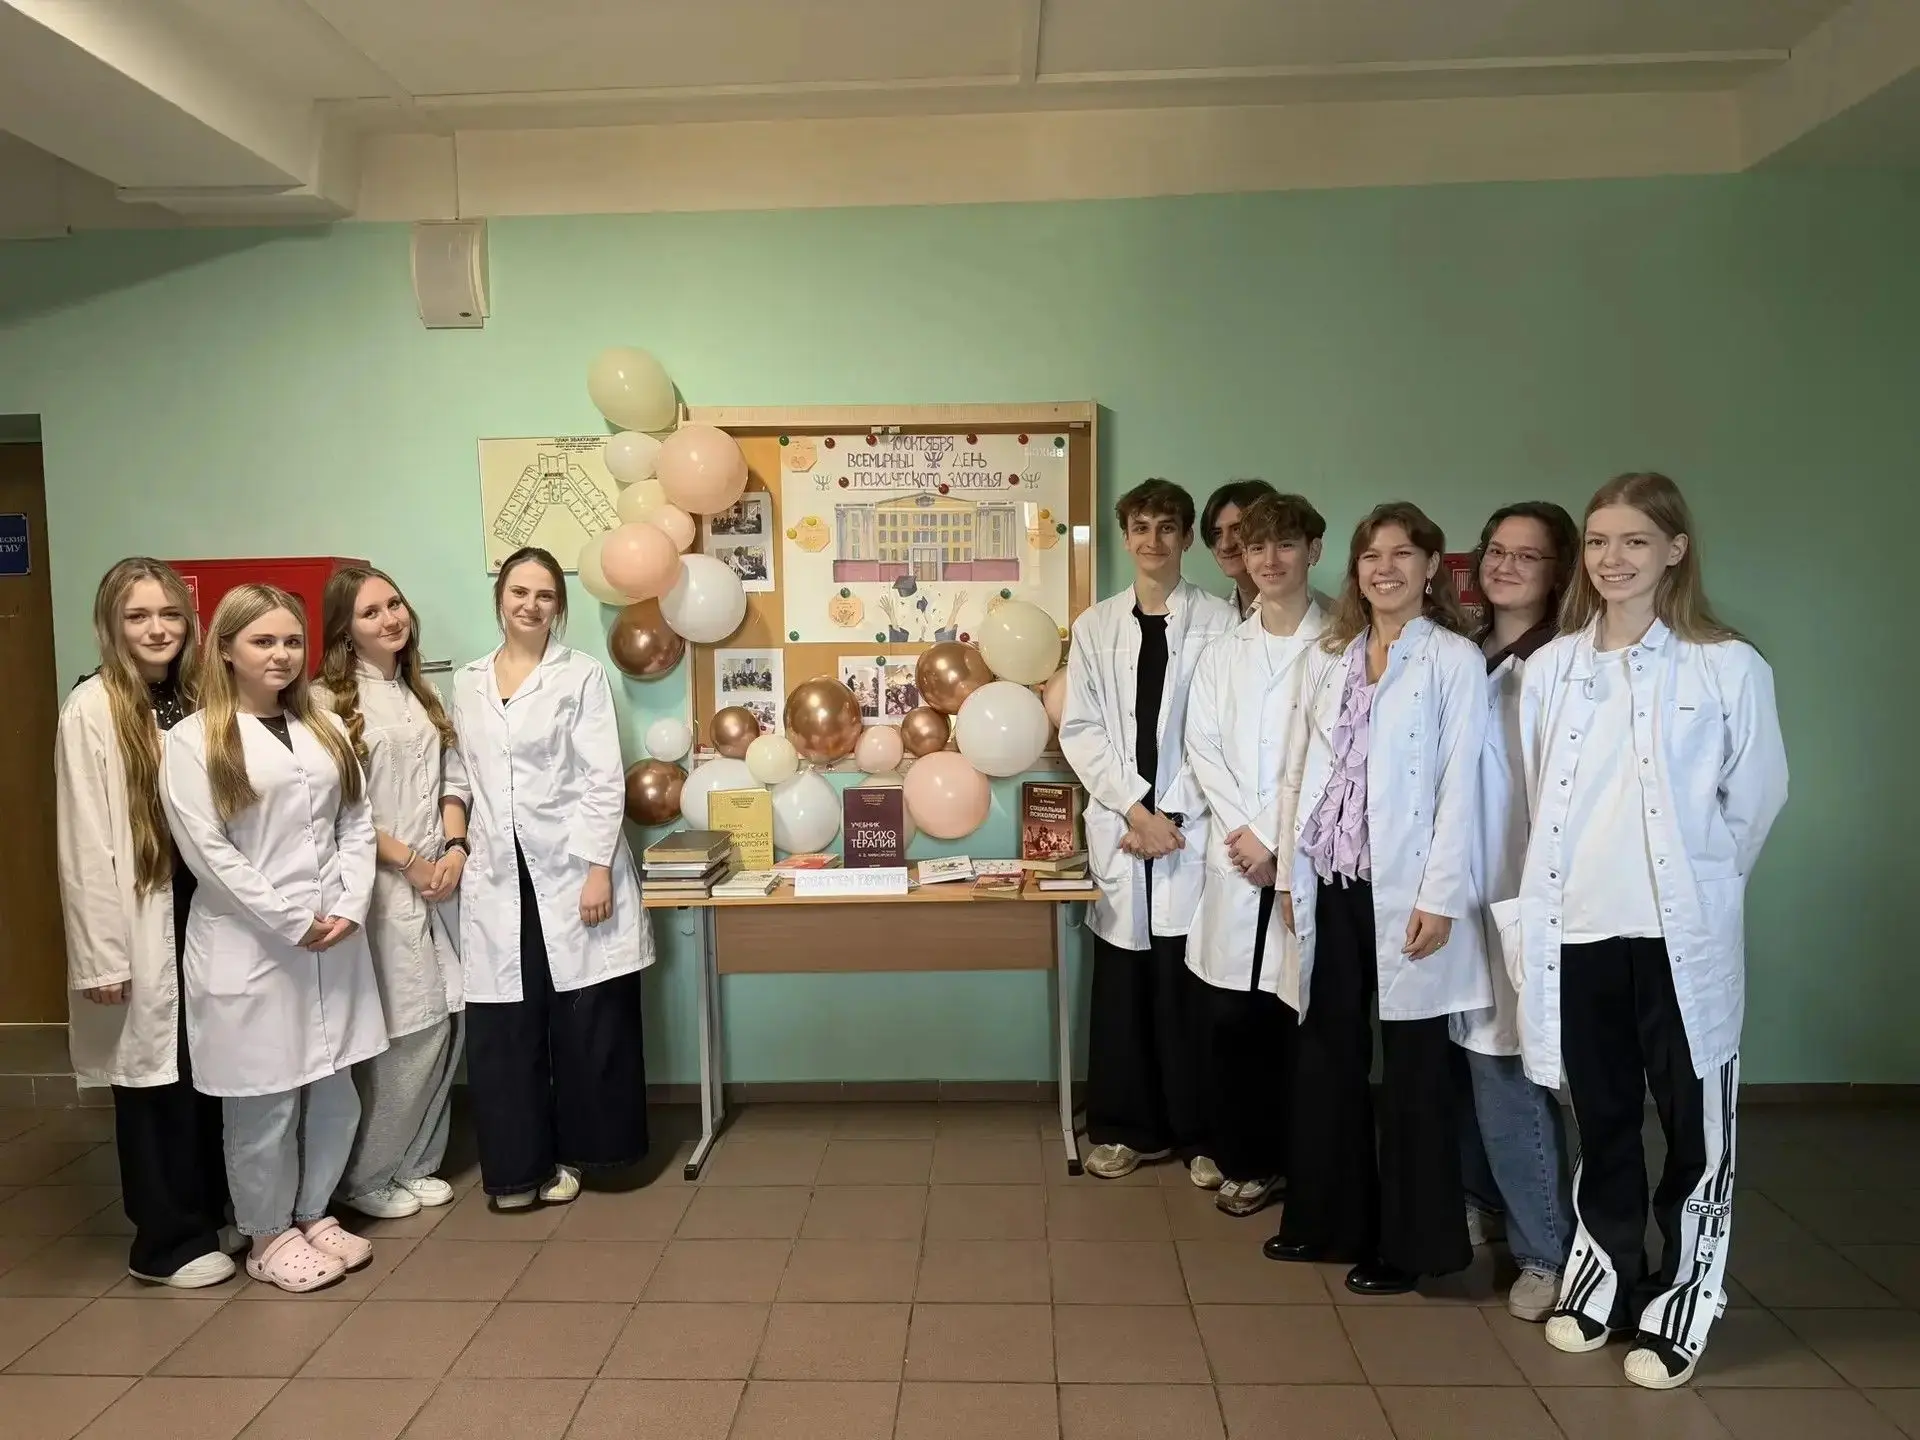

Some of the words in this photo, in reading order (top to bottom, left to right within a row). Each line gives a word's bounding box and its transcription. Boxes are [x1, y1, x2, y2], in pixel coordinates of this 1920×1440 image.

[890, 436, 902, 450] 10
[903, 436, 954, 451] ОКТЯБРЯ
[952, 452, 987, 468] ДЕНЬ
[854, 471, 941, 488] ПСИХИЧЕСКОГО
[1029, 805, 1067, 814] СОЦИАЛЬНАЯ
[1029, 811, 1067, 821] ПСИХОЛОГИЯ
[857, 830, 897, 840] ПСИХО
[851, 839, 896, 848] ТЕРАПИЯ
